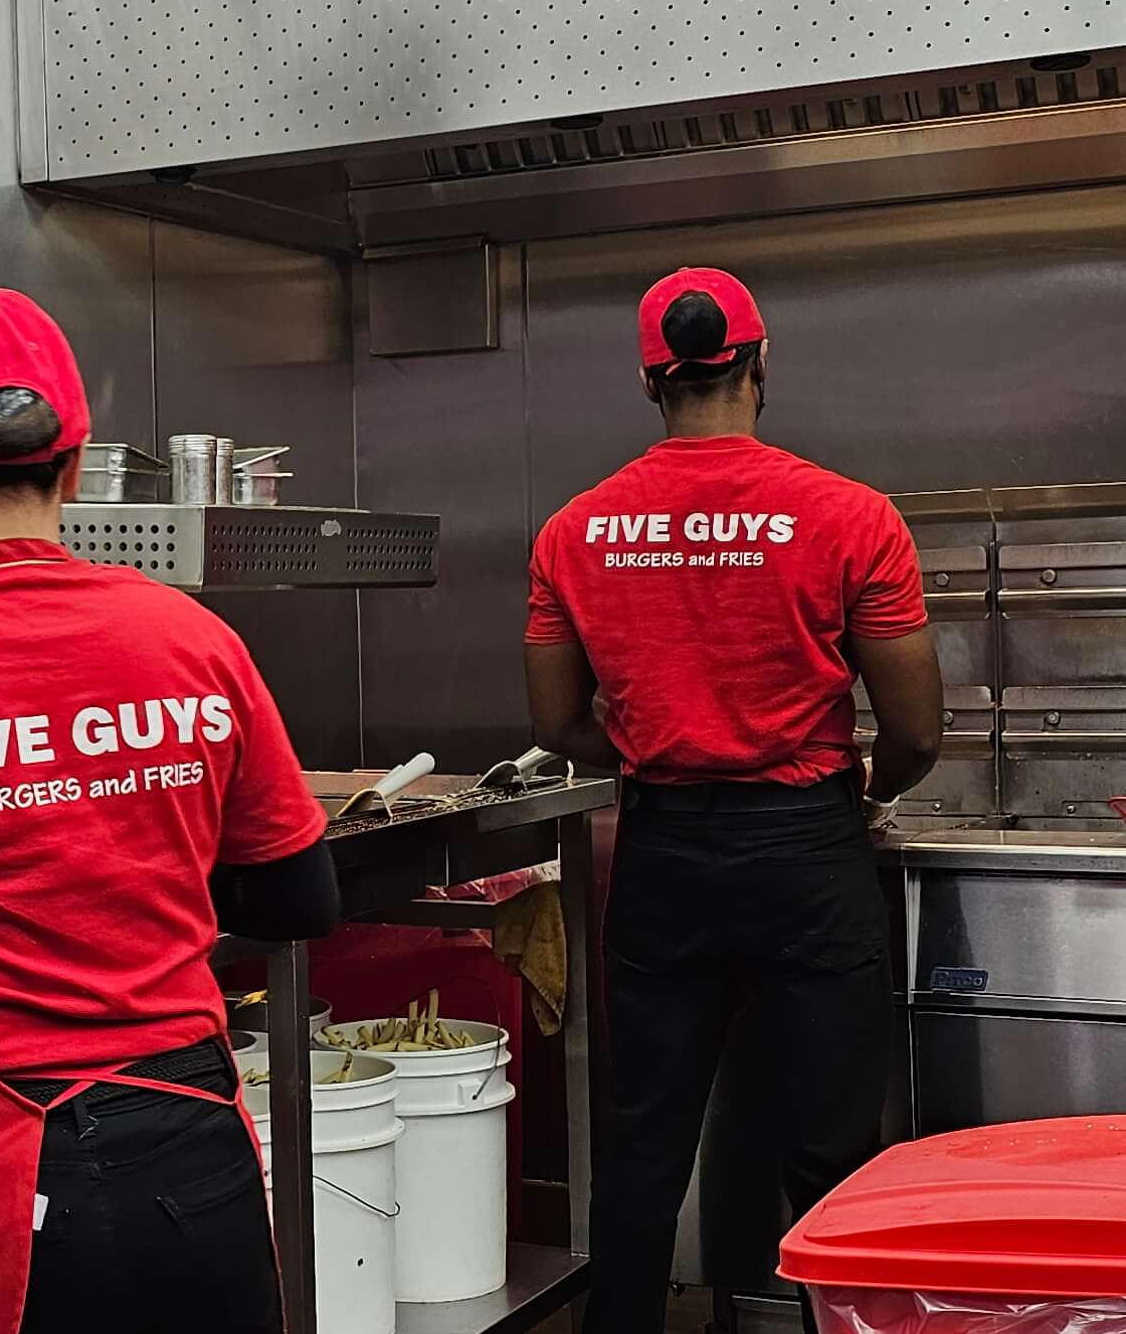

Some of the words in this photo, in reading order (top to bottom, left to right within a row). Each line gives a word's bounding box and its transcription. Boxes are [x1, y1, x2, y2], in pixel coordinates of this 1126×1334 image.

[585, 514, 671, 543] FIVE
[684, 513, 795, 543] GUYS
[605, 552, 684, 567] BURGERS
[688, 552, 715, 566] and
[719, 552, 764, 566] FRIES
[72, 694, 233, 756] GUYS
[89, 770, 136, 799] and
[143, 761, 204, 791] FRIES
